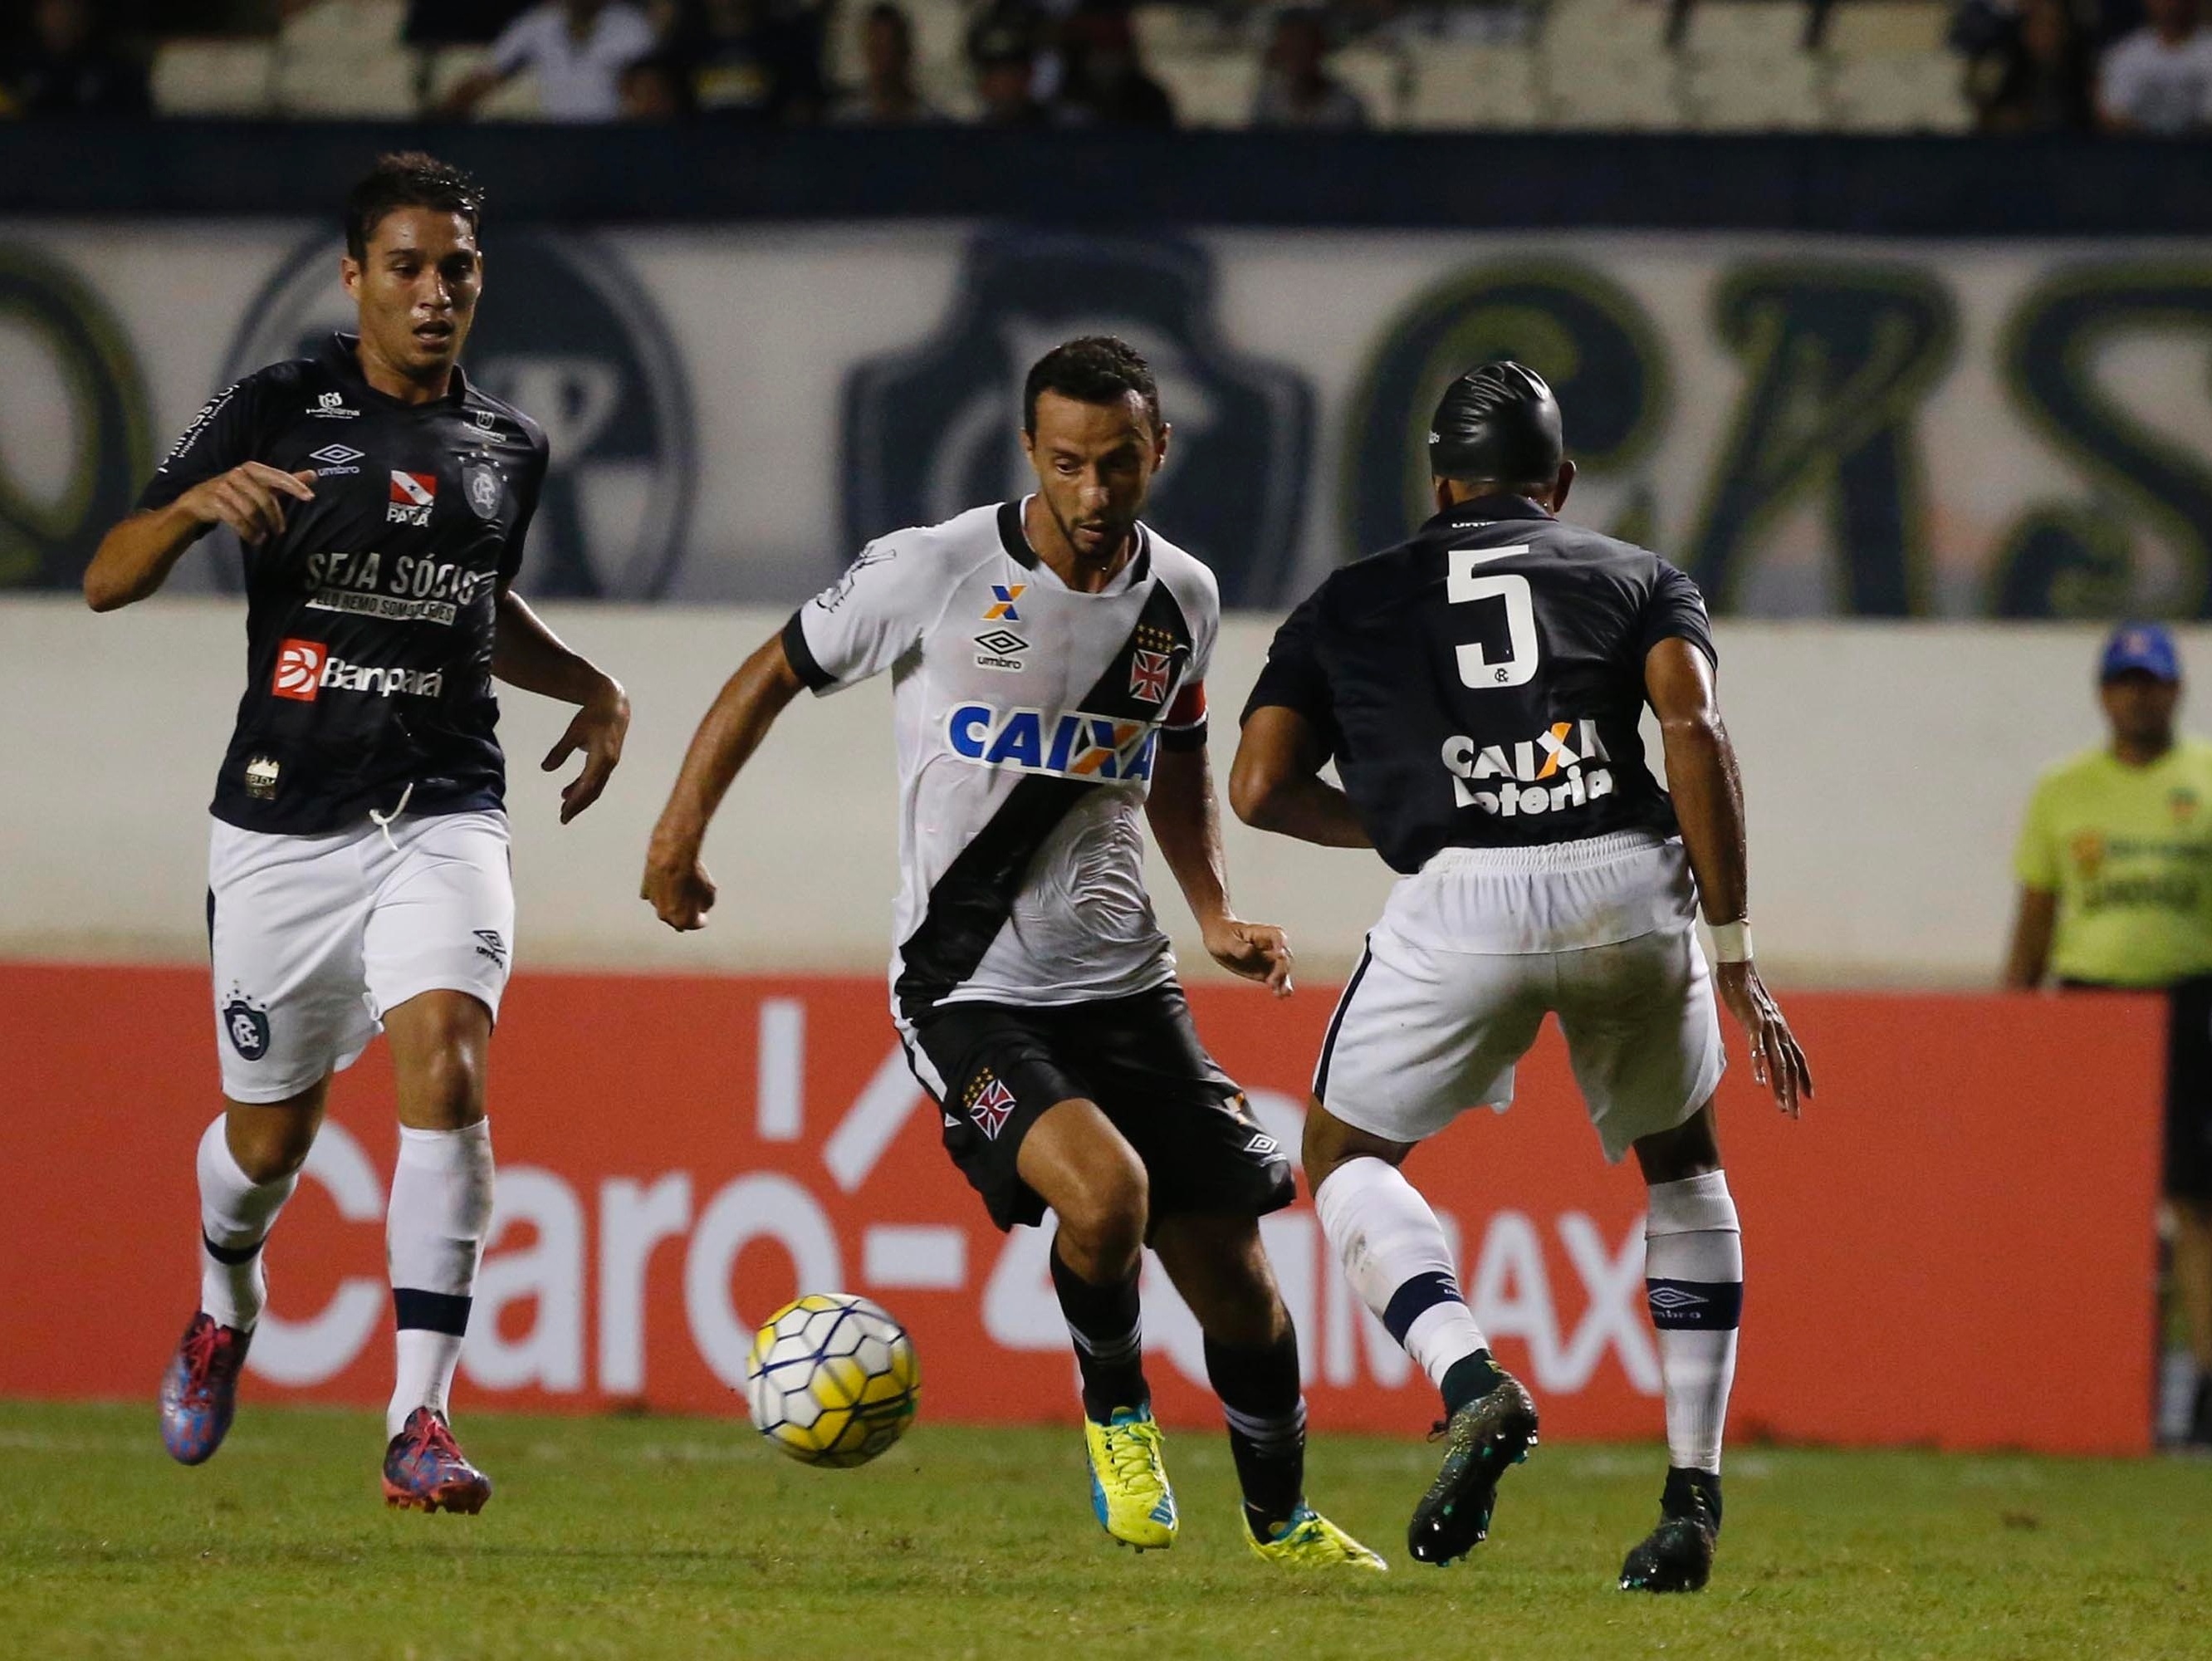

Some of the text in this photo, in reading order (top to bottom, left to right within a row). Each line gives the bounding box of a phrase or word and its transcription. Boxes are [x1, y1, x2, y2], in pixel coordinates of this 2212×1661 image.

[305, 552, 382, 592] SEJA
[1446, 544, 1539, 690] 5
[319, 657, 443, 698] Banpará
[976, 655, 1023, 670] umbro
[948, 704, 1159, 782] CAIXA
[1441, 718, 1613, 782] CAIXA
[237, 1113, 847, 1397] Caro
[1653, 1309, 1702, 1320] mbro
